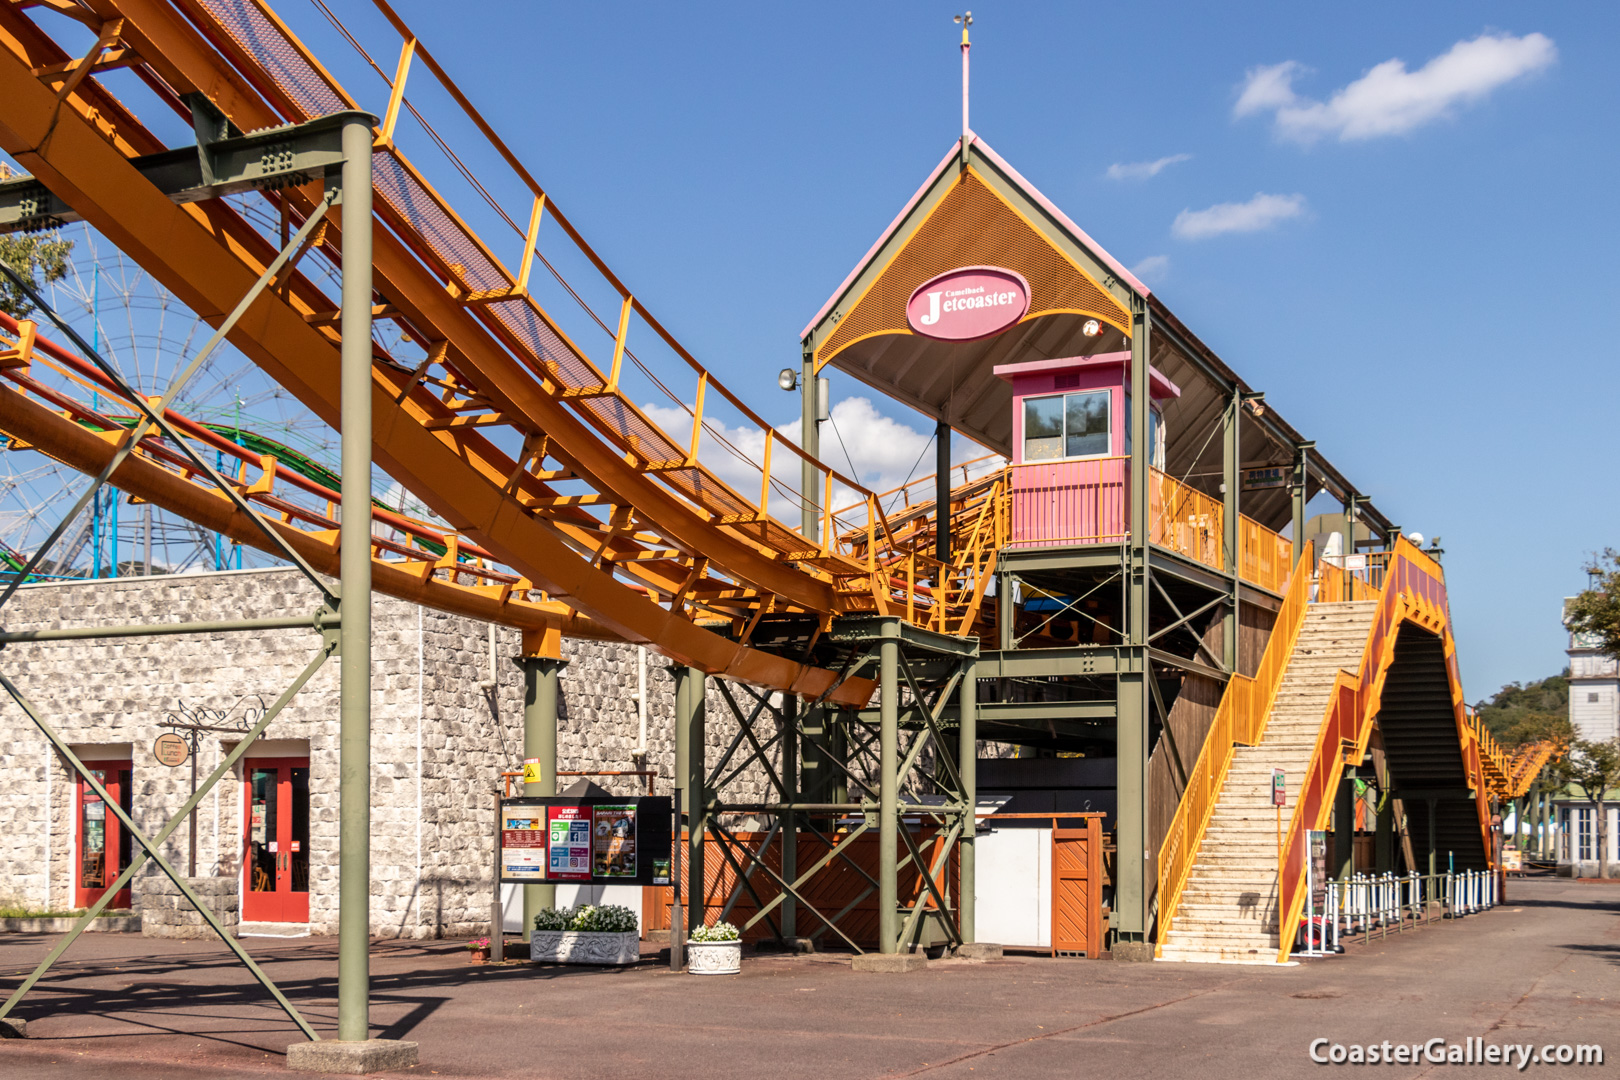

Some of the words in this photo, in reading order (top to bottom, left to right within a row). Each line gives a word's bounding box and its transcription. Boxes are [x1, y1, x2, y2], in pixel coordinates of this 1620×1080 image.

[945, 286, 985, 297] Camelback
[920, 291, 1016, 325] Jetcoaster
[1276, 792, 1285, 803] OUT
